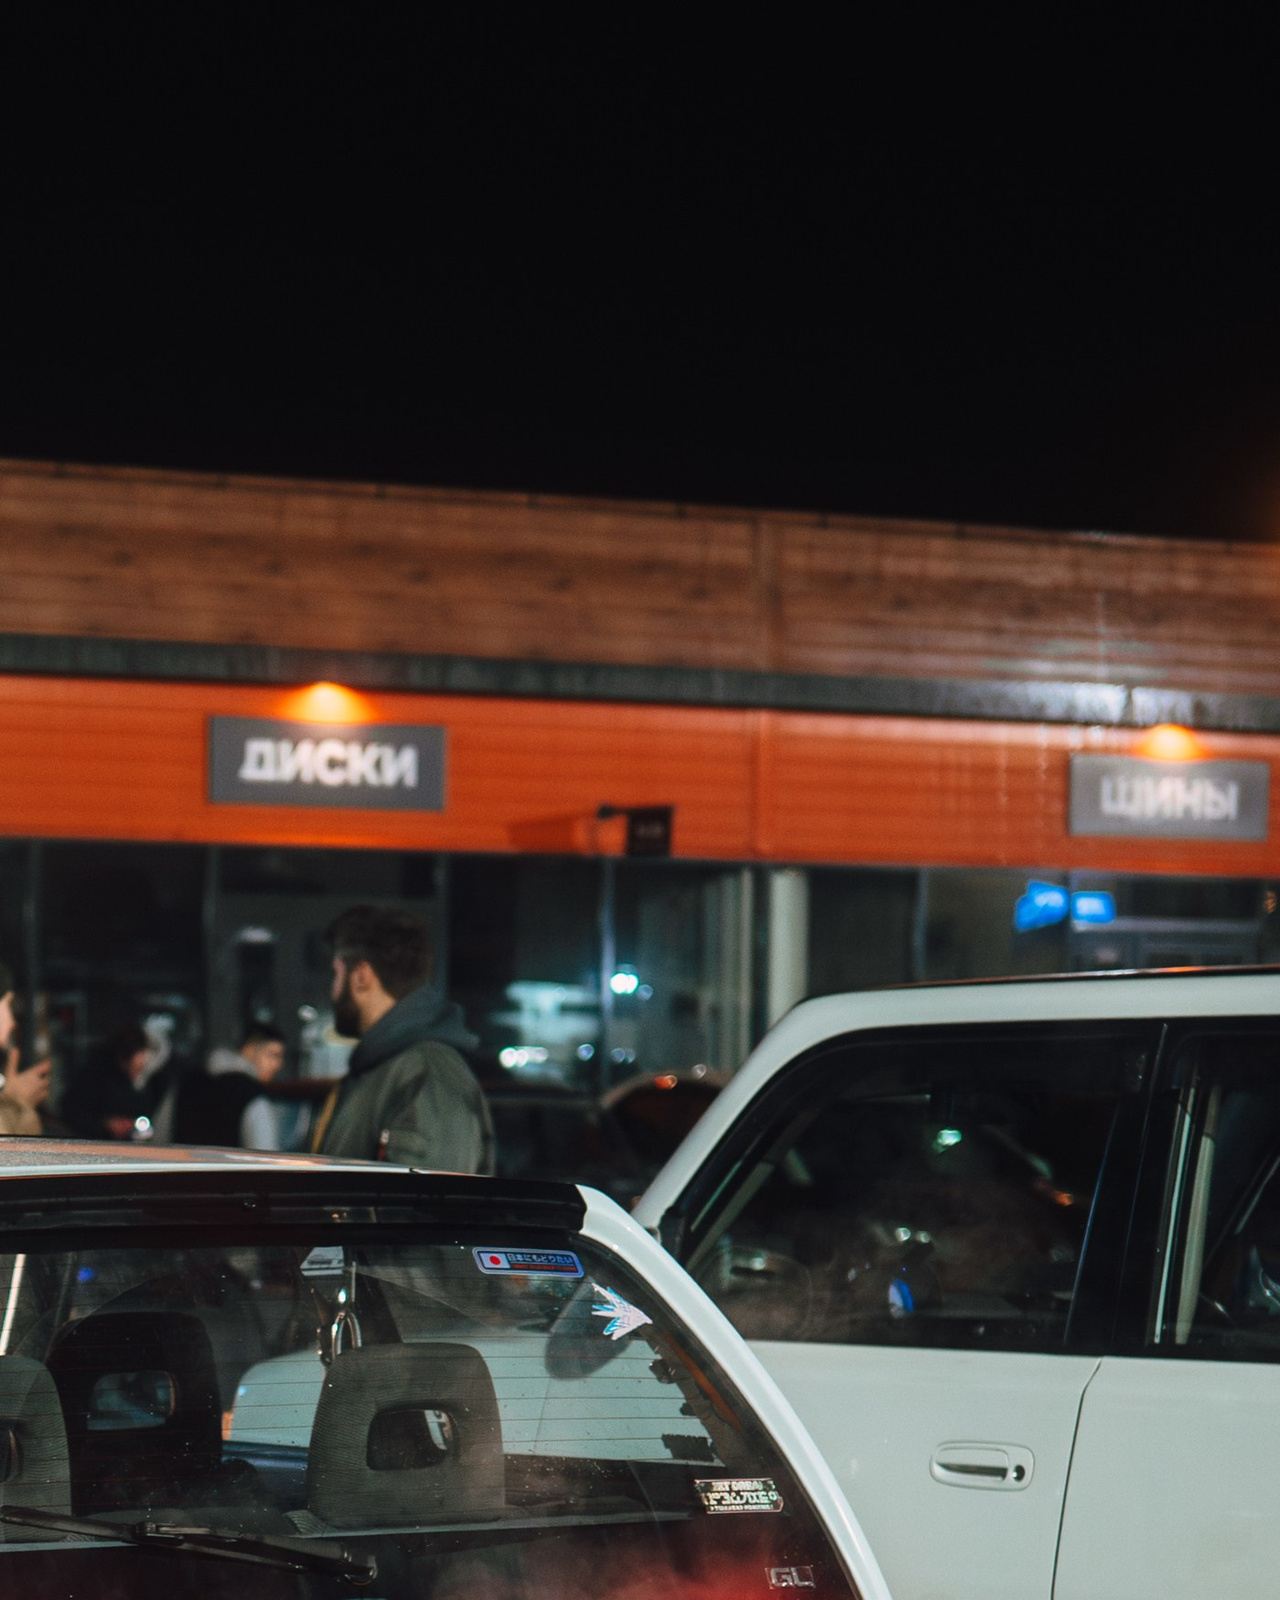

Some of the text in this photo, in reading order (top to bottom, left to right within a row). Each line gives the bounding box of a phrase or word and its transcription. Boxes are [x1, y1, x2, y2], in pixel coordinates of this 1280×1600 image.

[238, 737, 419, 788] ДИСКИ
[1100, 774, 1239, 821] ШИНЫ
[770, 1566, 815, 1588] GL
